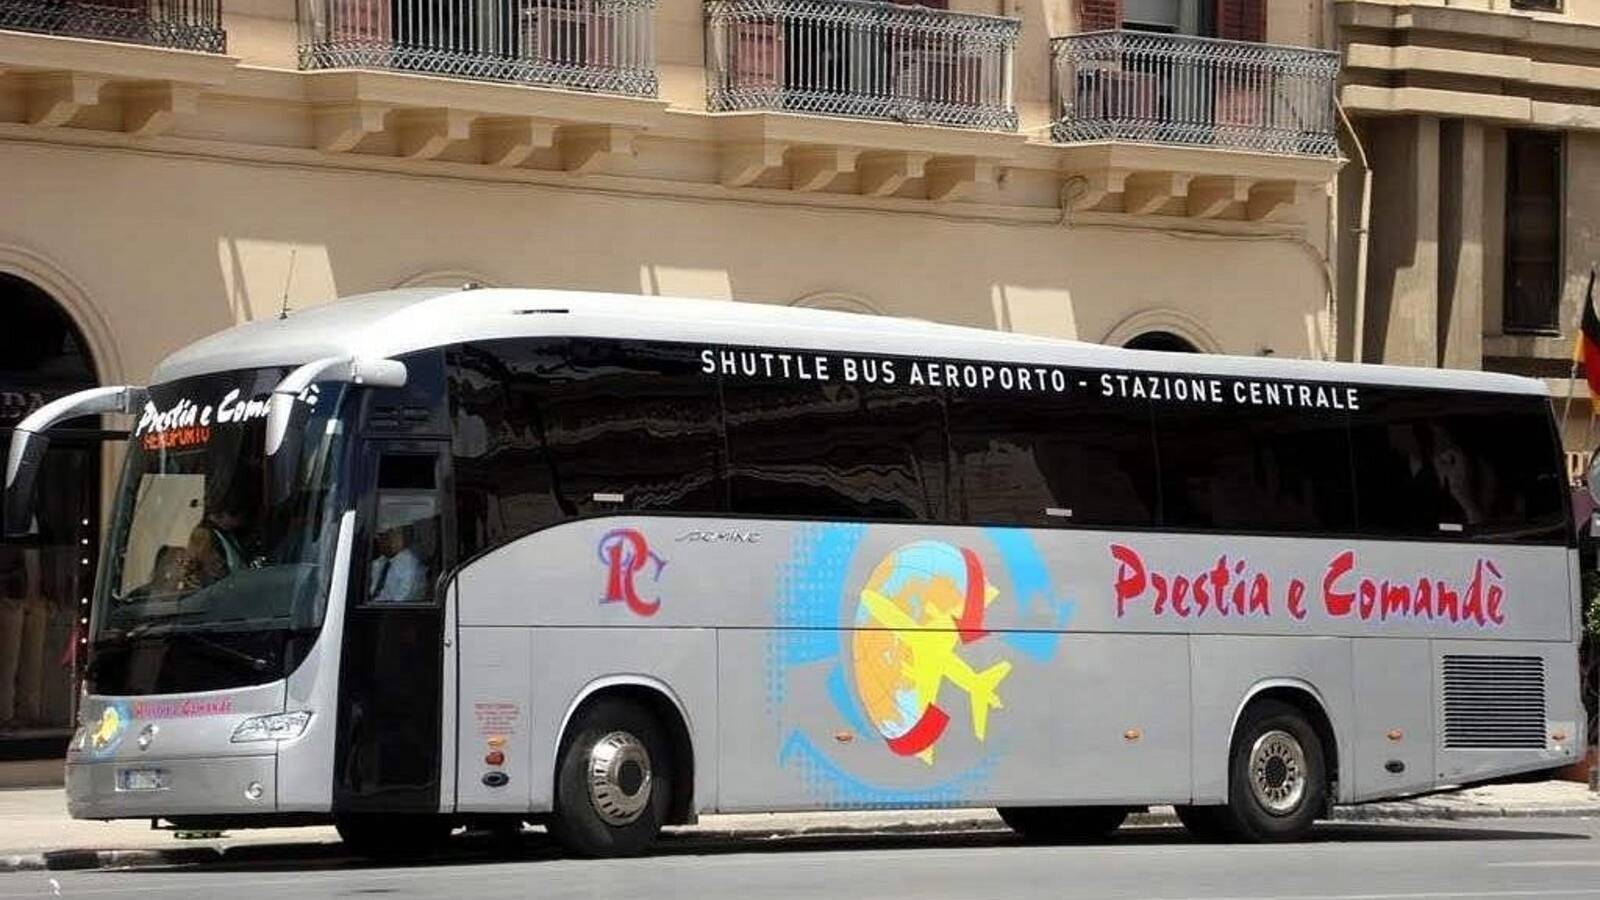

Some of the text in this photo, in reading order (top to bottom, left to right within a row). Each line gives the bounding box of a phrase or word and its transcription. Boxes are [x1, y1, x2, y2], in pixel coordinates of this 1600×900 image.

[701, 349, 830, 382] SHUTTLE
[843, 357, 896, 385] BUS
[909, 362, 1066, 393] AEROPORTO
[1100, 373, 1224, 404] STAZIONE
[1234, 381, 1361, 411] CENTRALE
[134, 398, 198, 438] Prestia
[200, 405, 213, 427] e
[1110, 543, 1505, 625] Prestia e Comandè
